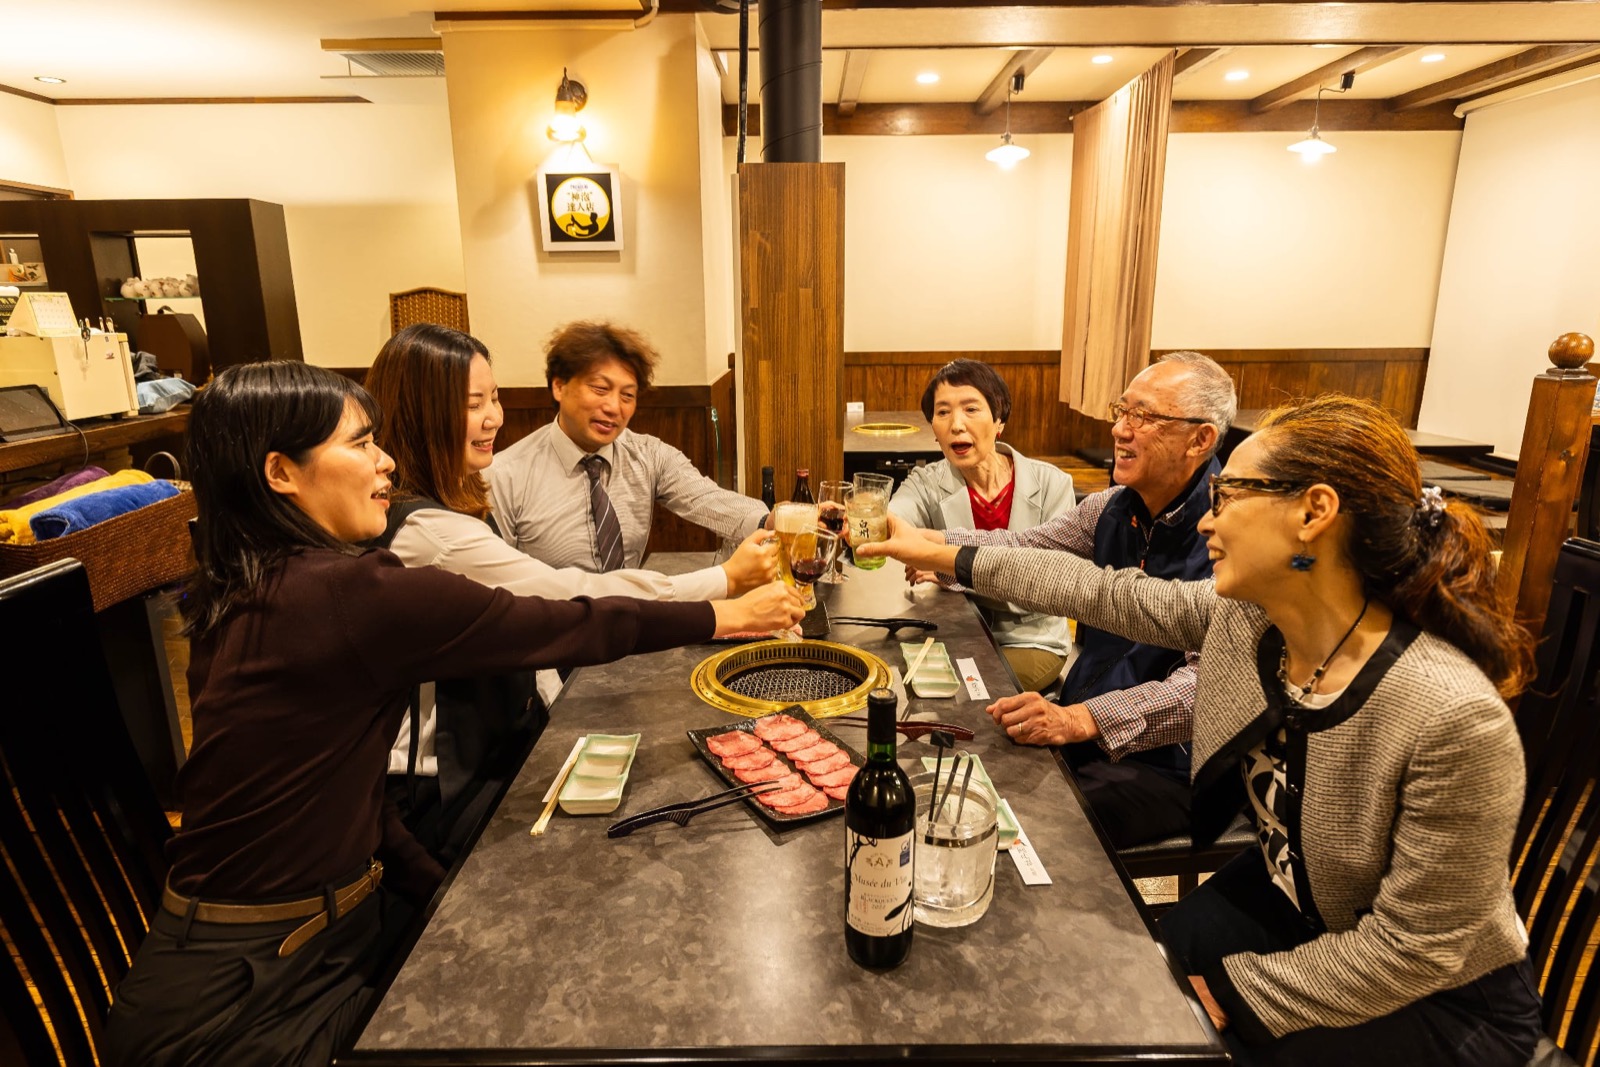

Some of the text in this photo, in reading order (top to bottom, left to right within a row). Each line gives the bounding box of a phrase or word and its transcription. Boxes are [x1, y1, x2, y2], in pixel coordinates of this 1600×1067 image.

[859, 519, 870, 538] 白州
[853, 872, 878, 888] Musée
[880, 877, 892, 888] du
